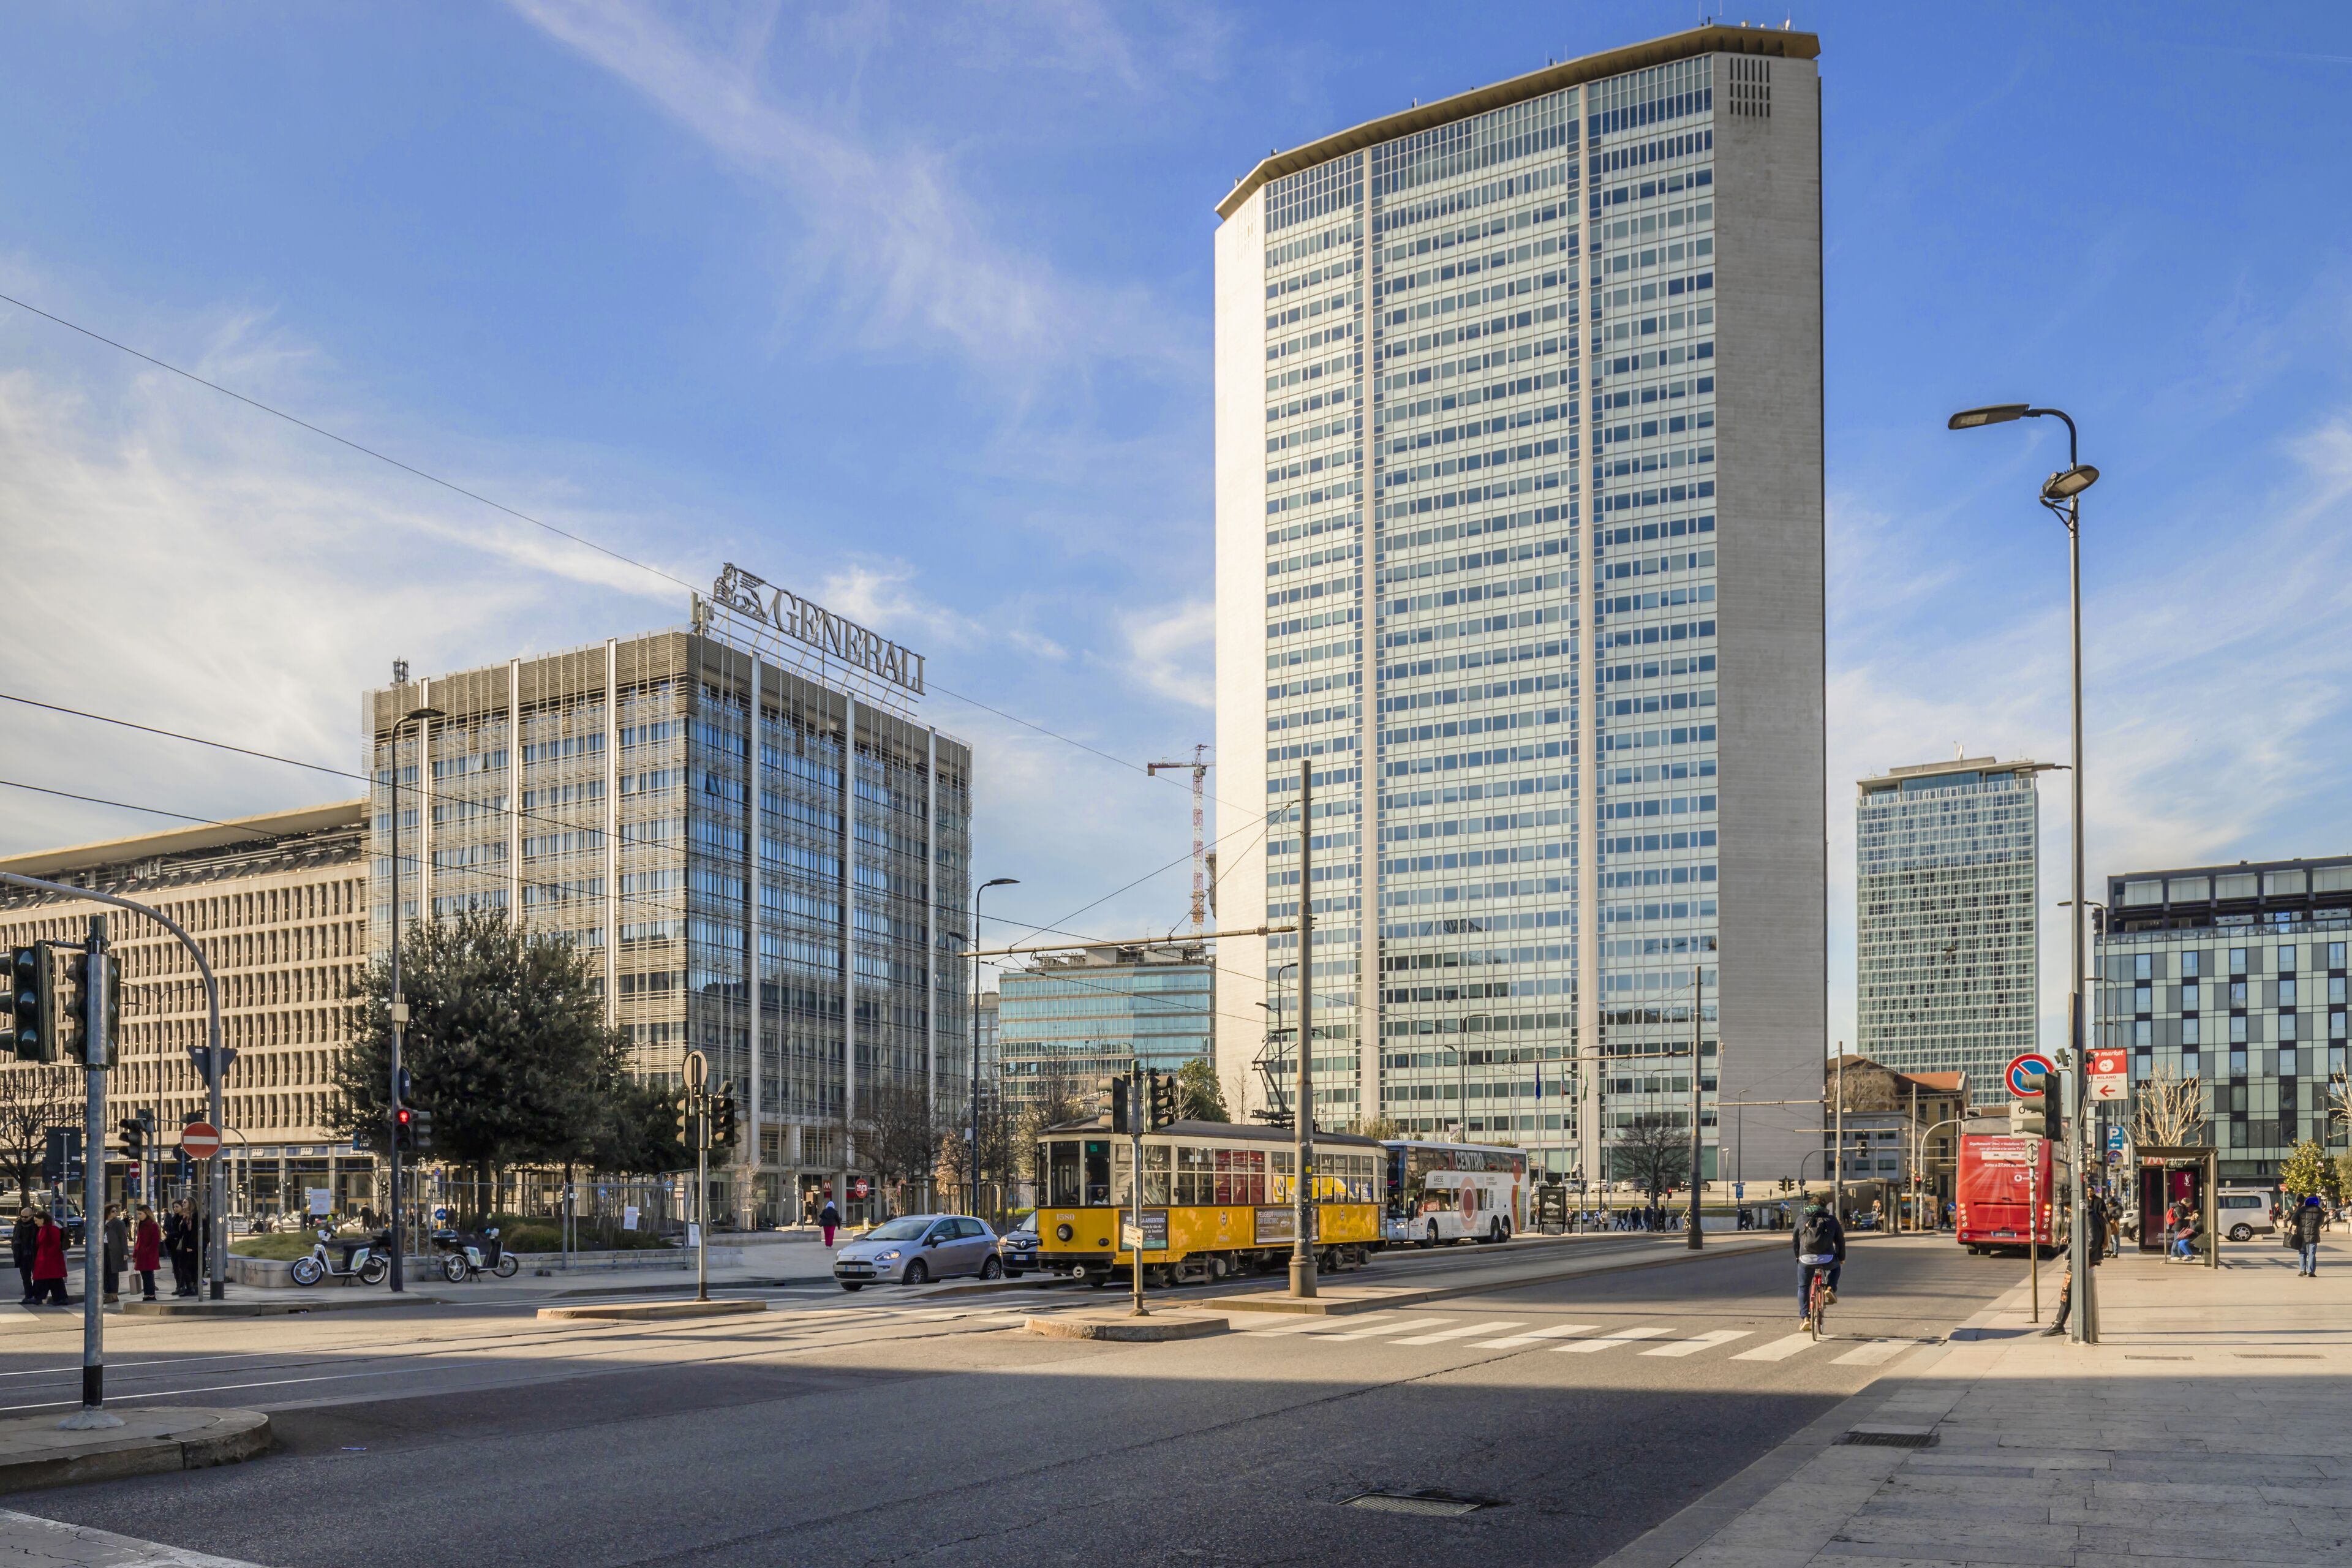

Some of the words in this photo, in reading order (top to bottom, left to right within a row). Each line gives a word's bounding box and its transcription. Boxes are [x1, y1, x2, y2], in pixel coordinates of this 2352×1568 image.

[773, 589, 926, 696] GENERALI
[2109, 1128, 2119, 1139] P
[1042, 1144, 1046, 1155] 5
[1455, 1152, 1484, 1170] CENTRO
